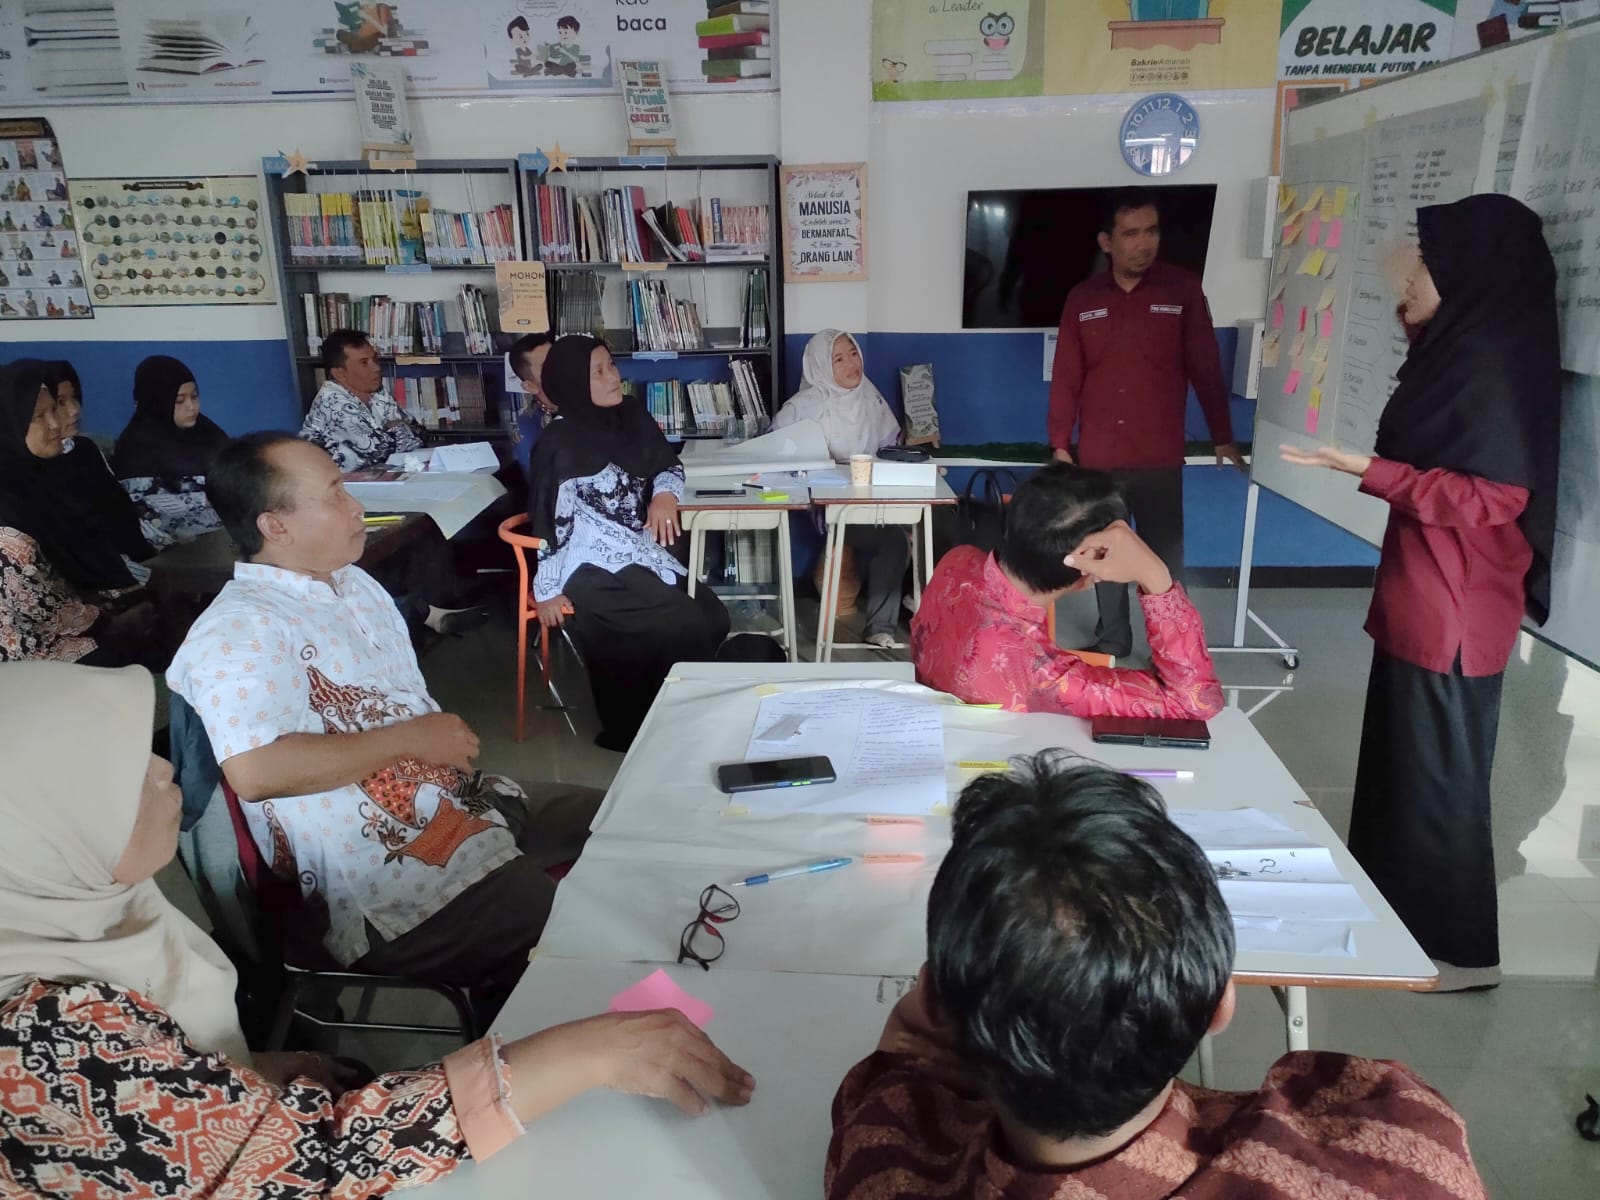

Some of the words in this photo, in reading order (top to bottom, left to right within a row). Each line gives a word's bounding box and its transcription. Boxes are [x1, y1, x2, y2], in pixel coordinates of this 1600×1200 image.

[617, 14, 667, 31] baca
[1295, 22, 1437, 57] BELAJAR
[1285, 65, 1320, 76] TANPA
[1322, 63, 1376, 75] MENGENAL
[1380, 61, 1416, 73] PUTUS
[1142, 101, 1155, 113] 11
[1157, 98, 1171, 110] 12
[799, 200, 851, 216] MANUSIA
[801, 228, 852, 239] BERMANFAAT
[800, 251, 831, 264] ORANG
[832, 250, 853, 262] LAIN
[509, 271, 545, 280] MOHON
[1258, 858, 1283, 874] 2
